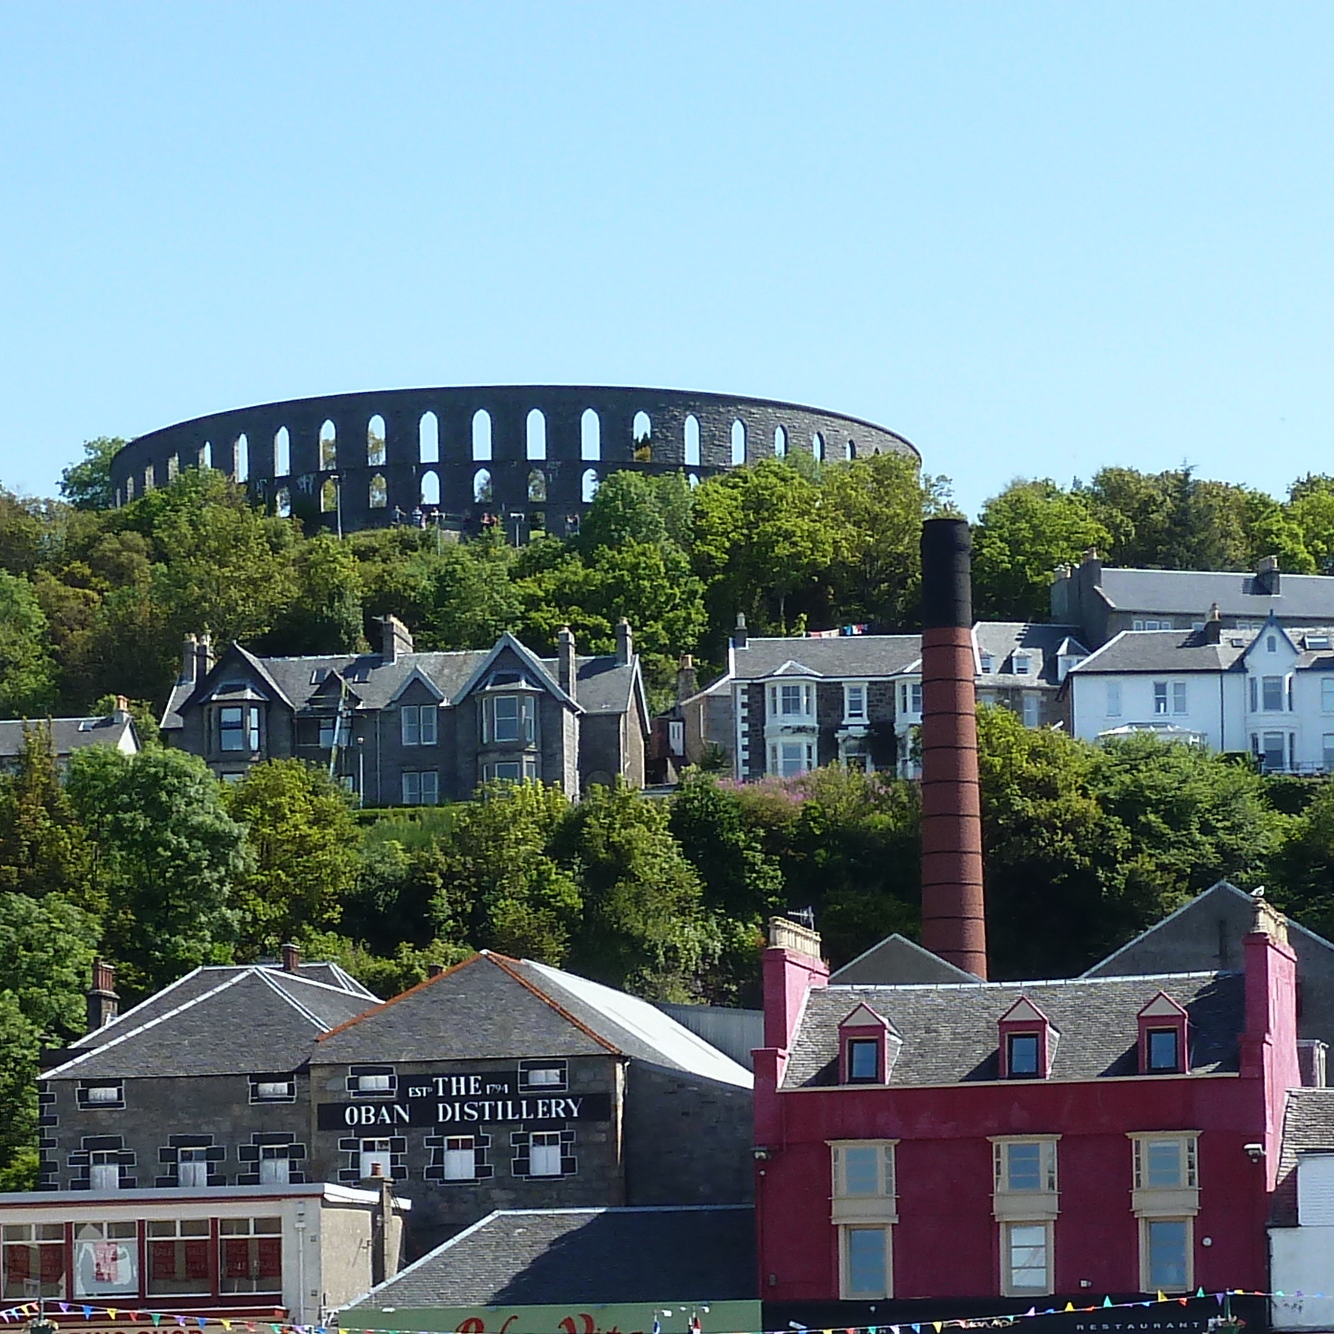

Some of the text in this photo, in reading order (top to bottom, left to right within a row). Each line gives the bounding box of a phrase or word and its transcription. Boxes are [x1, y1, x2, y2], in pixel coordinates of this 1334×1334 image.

[432, 1075, 483, 1096] THE
[485, 1083, 509, 1095] 1794
[344, 1097, 583, 1125] OBAN DISTILLERY
[1075, 1320, 1200, 1331] RESTAURANT
